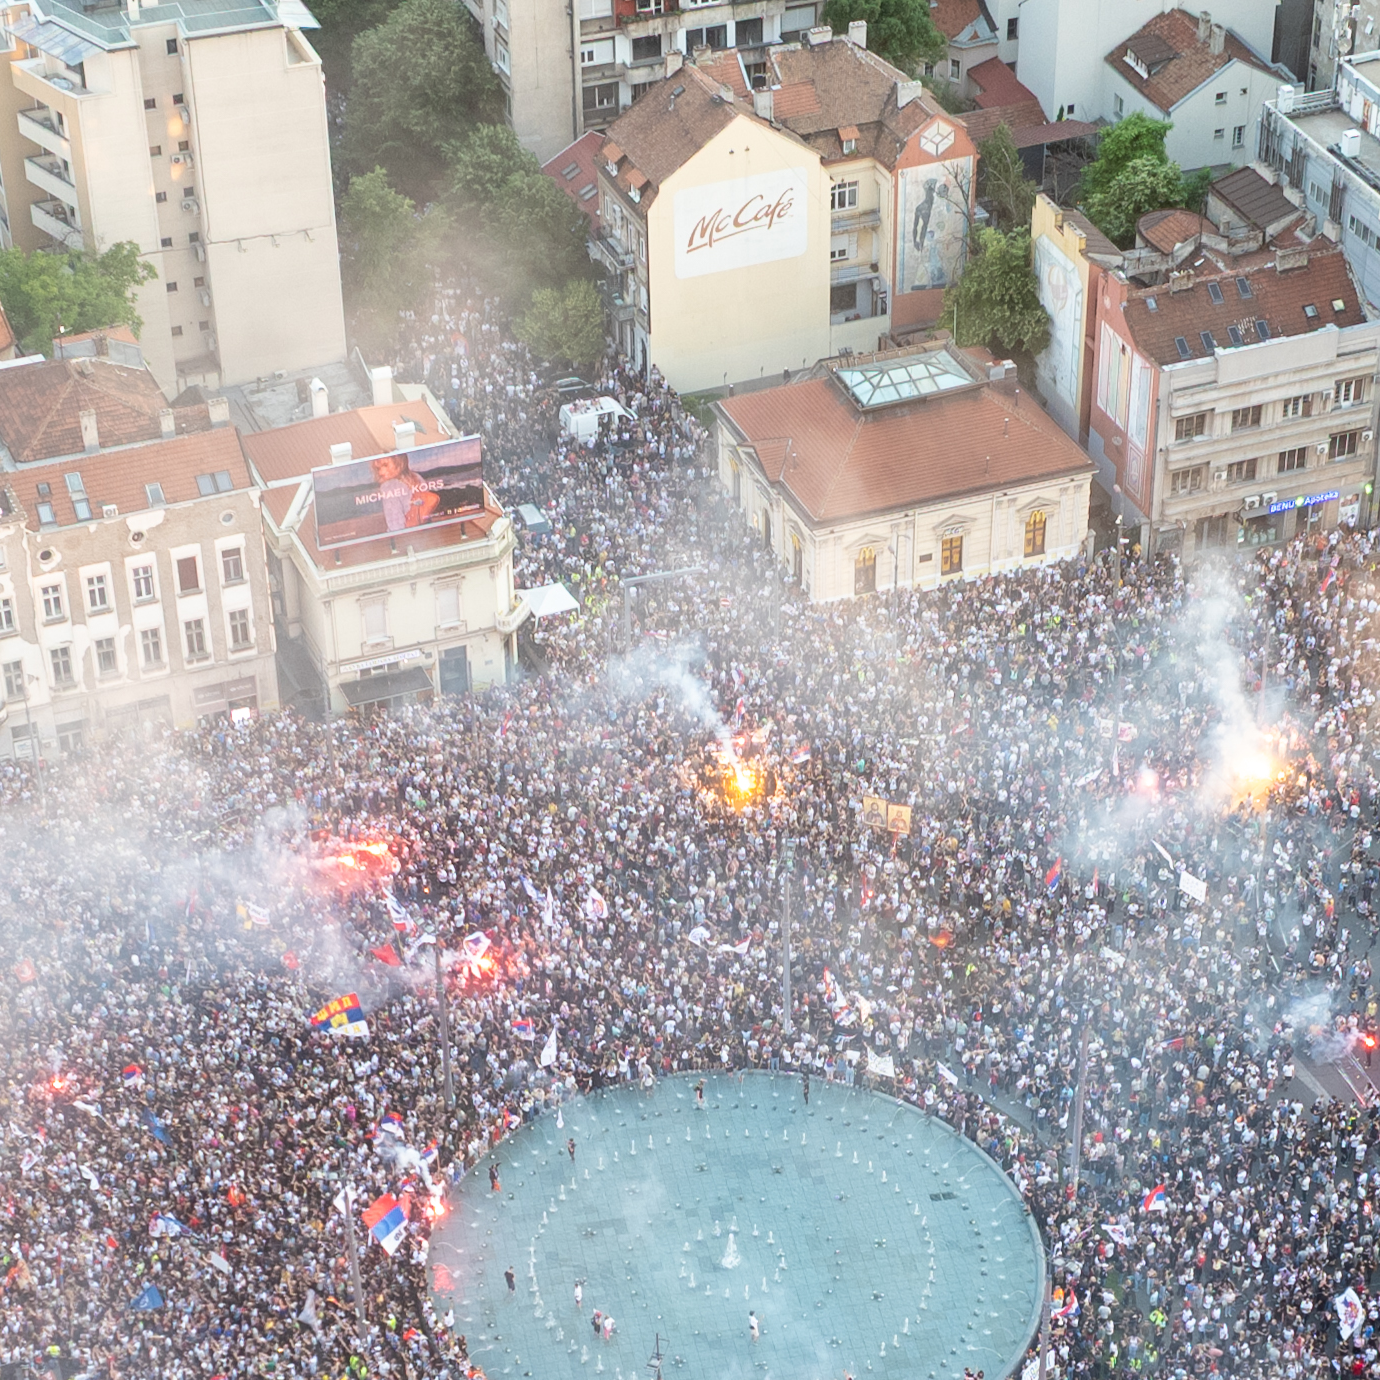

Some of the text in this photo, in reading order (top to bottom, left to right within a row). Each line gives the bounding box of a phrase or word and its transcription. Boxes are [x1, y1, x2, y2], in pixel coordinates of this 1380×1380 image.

[355, 479, 444, 506] MICHAEL KORS
[1270, 491, 1339, 513] BENU Apoteka
